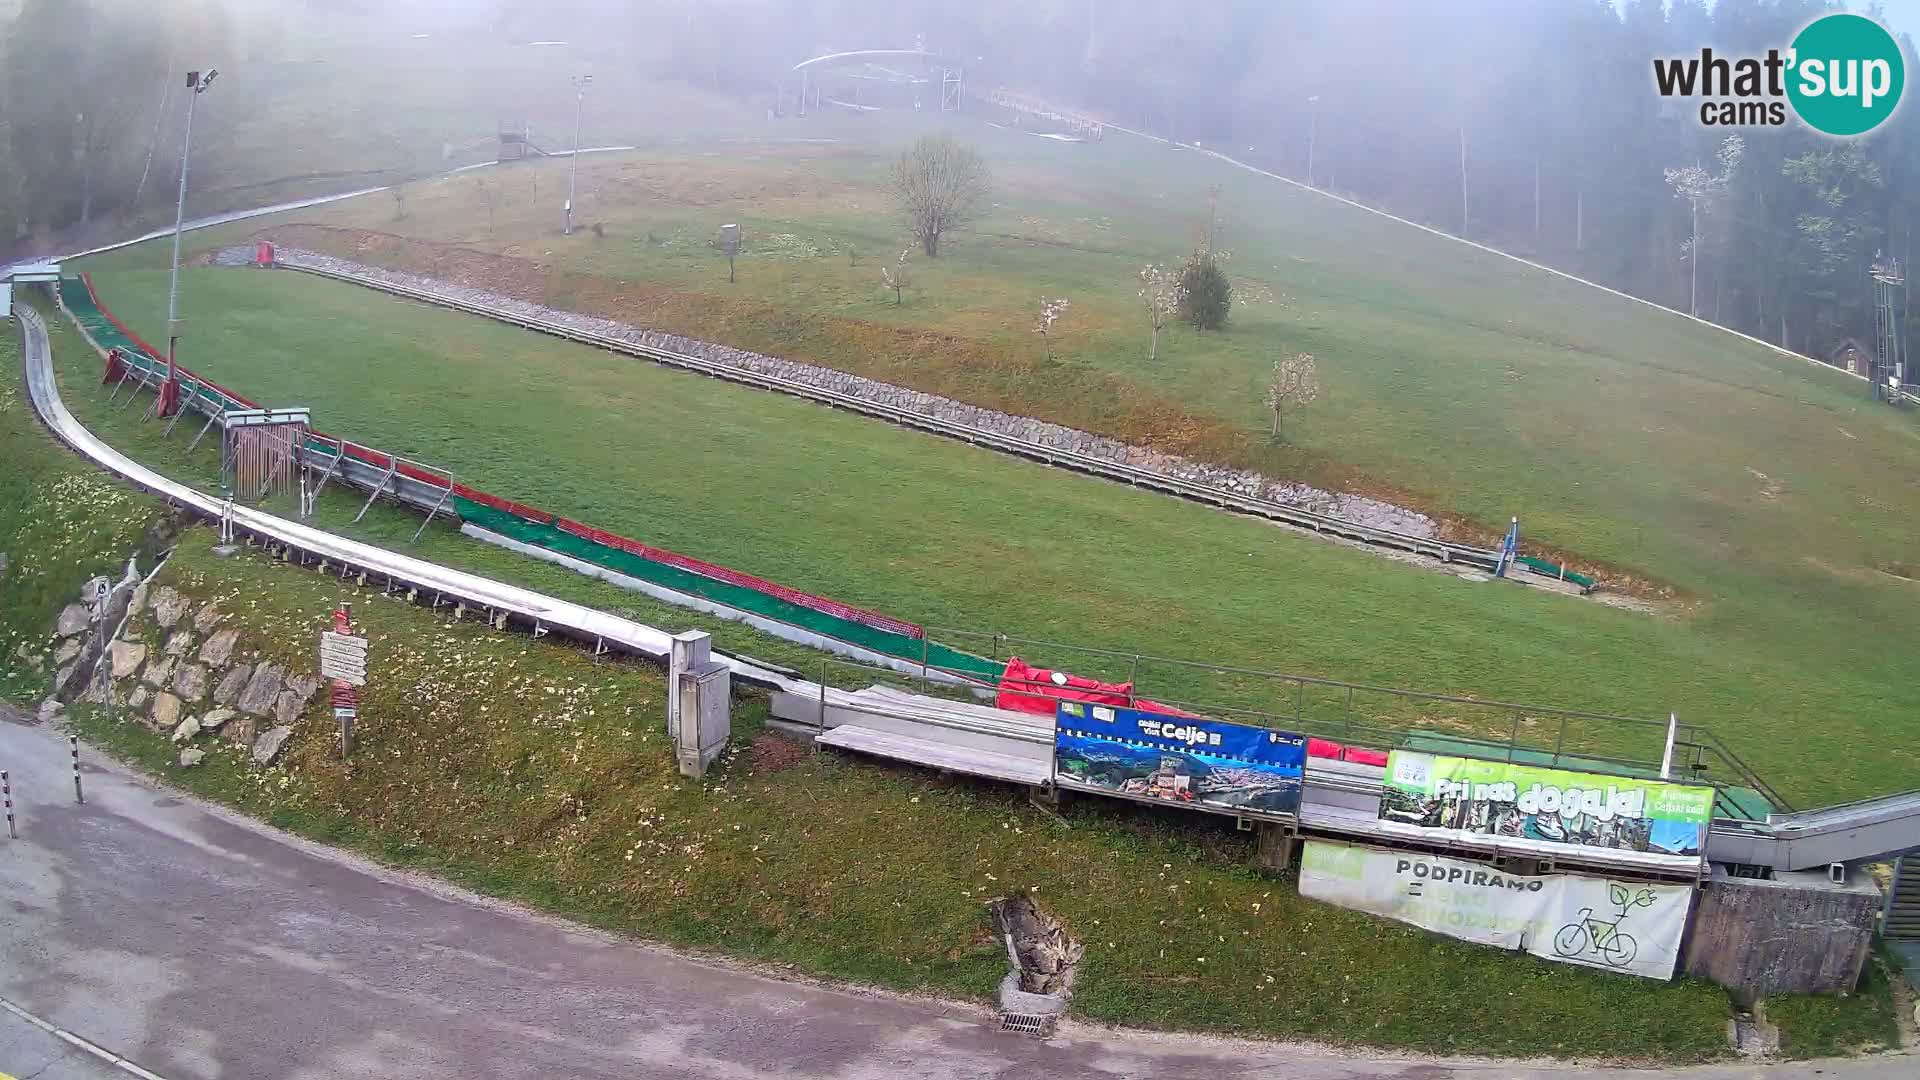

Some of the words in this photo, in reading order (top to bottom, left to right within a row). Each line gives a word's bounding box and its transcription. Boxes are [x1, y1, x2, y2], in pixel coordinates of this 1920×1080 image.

[1162, 723, 1207, 745] Celje
[1434, 778, 1471, 801] Pri
[1473, 780, 1516, 802] nas
[1396, 859, 1544, 893] PODPIRAMO
